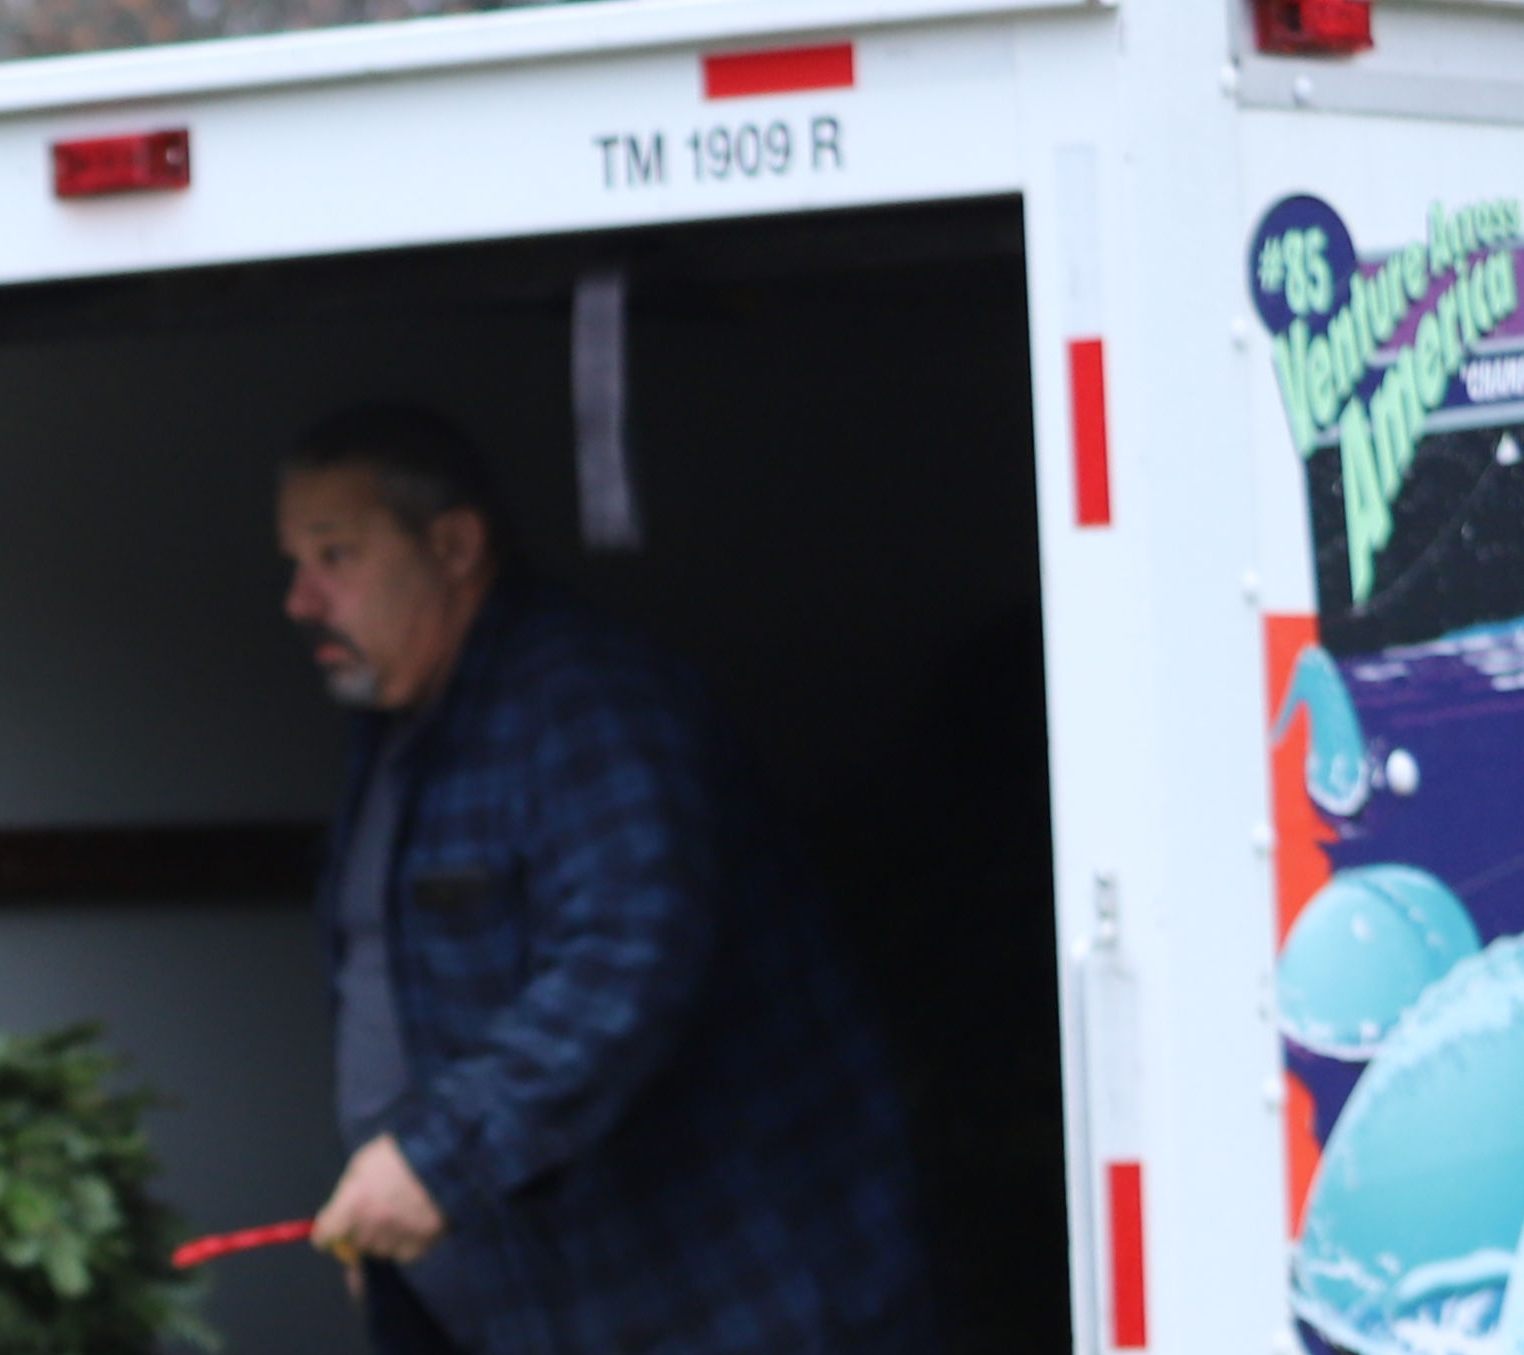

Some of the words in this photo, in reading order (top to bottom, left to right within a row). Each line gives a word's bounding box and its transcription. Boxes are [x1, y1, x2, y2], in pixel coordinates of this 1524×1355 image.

[592, 131, 665, 188] TM
[685, 119, 793, 183] 1909
[811, 114, 844, 171] R
[1256, 223, 1335, 316] #85
[1272, 240, 1428, 461] Venture
[1428, 197, 1520, 278] Across
[1338, 247, 1517, 607] America
